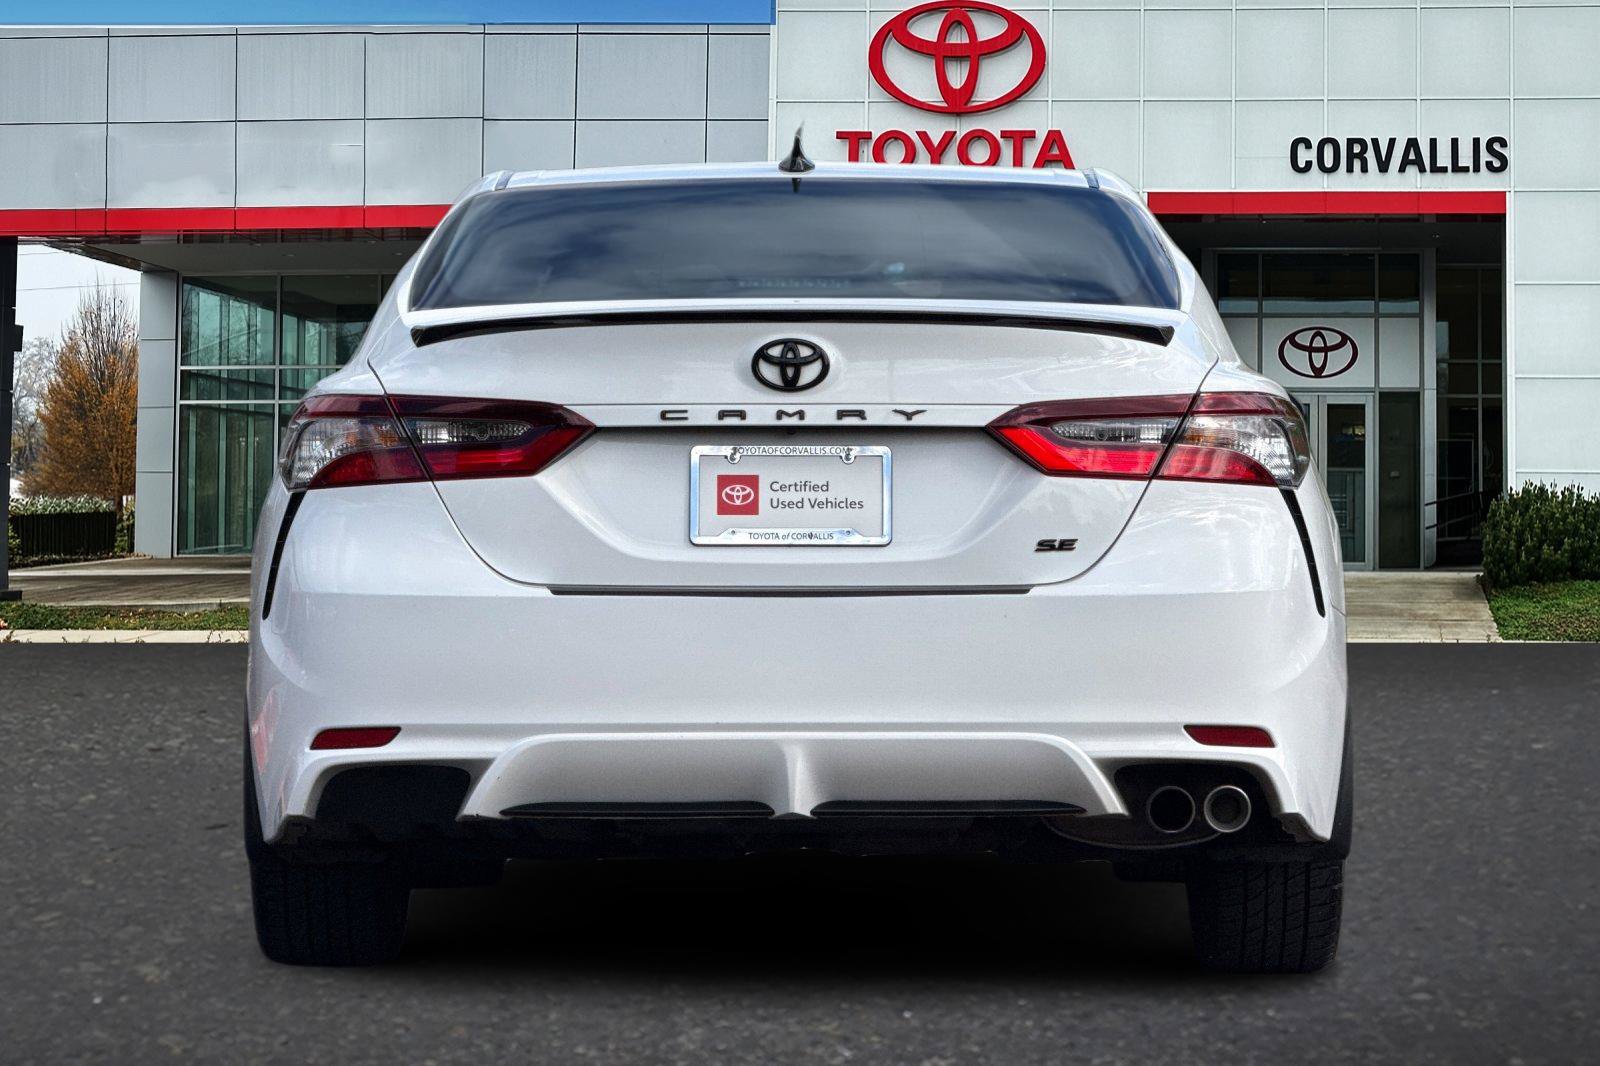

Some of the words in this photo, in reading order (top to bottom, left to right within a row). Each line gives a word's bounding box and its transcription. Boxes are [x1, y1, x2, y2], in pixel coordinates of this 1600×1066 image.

[836, 129, 1076, 170] TOYOTA
[1290, 136, 1508, 173] CORVALLIS
[660, 408, 928, 421] CAMRY
[769, 480, 830, 492] Certified
[770, 497, 805, 509] Used
[808, 497, 864, 509] Vehicles
[748, 532, 780, 540] TOYOTA
[781, 532, 790, 540] of
[791, 532, 834, 540] CORVALLIS
[1034, 538, 1078, 552] SE
